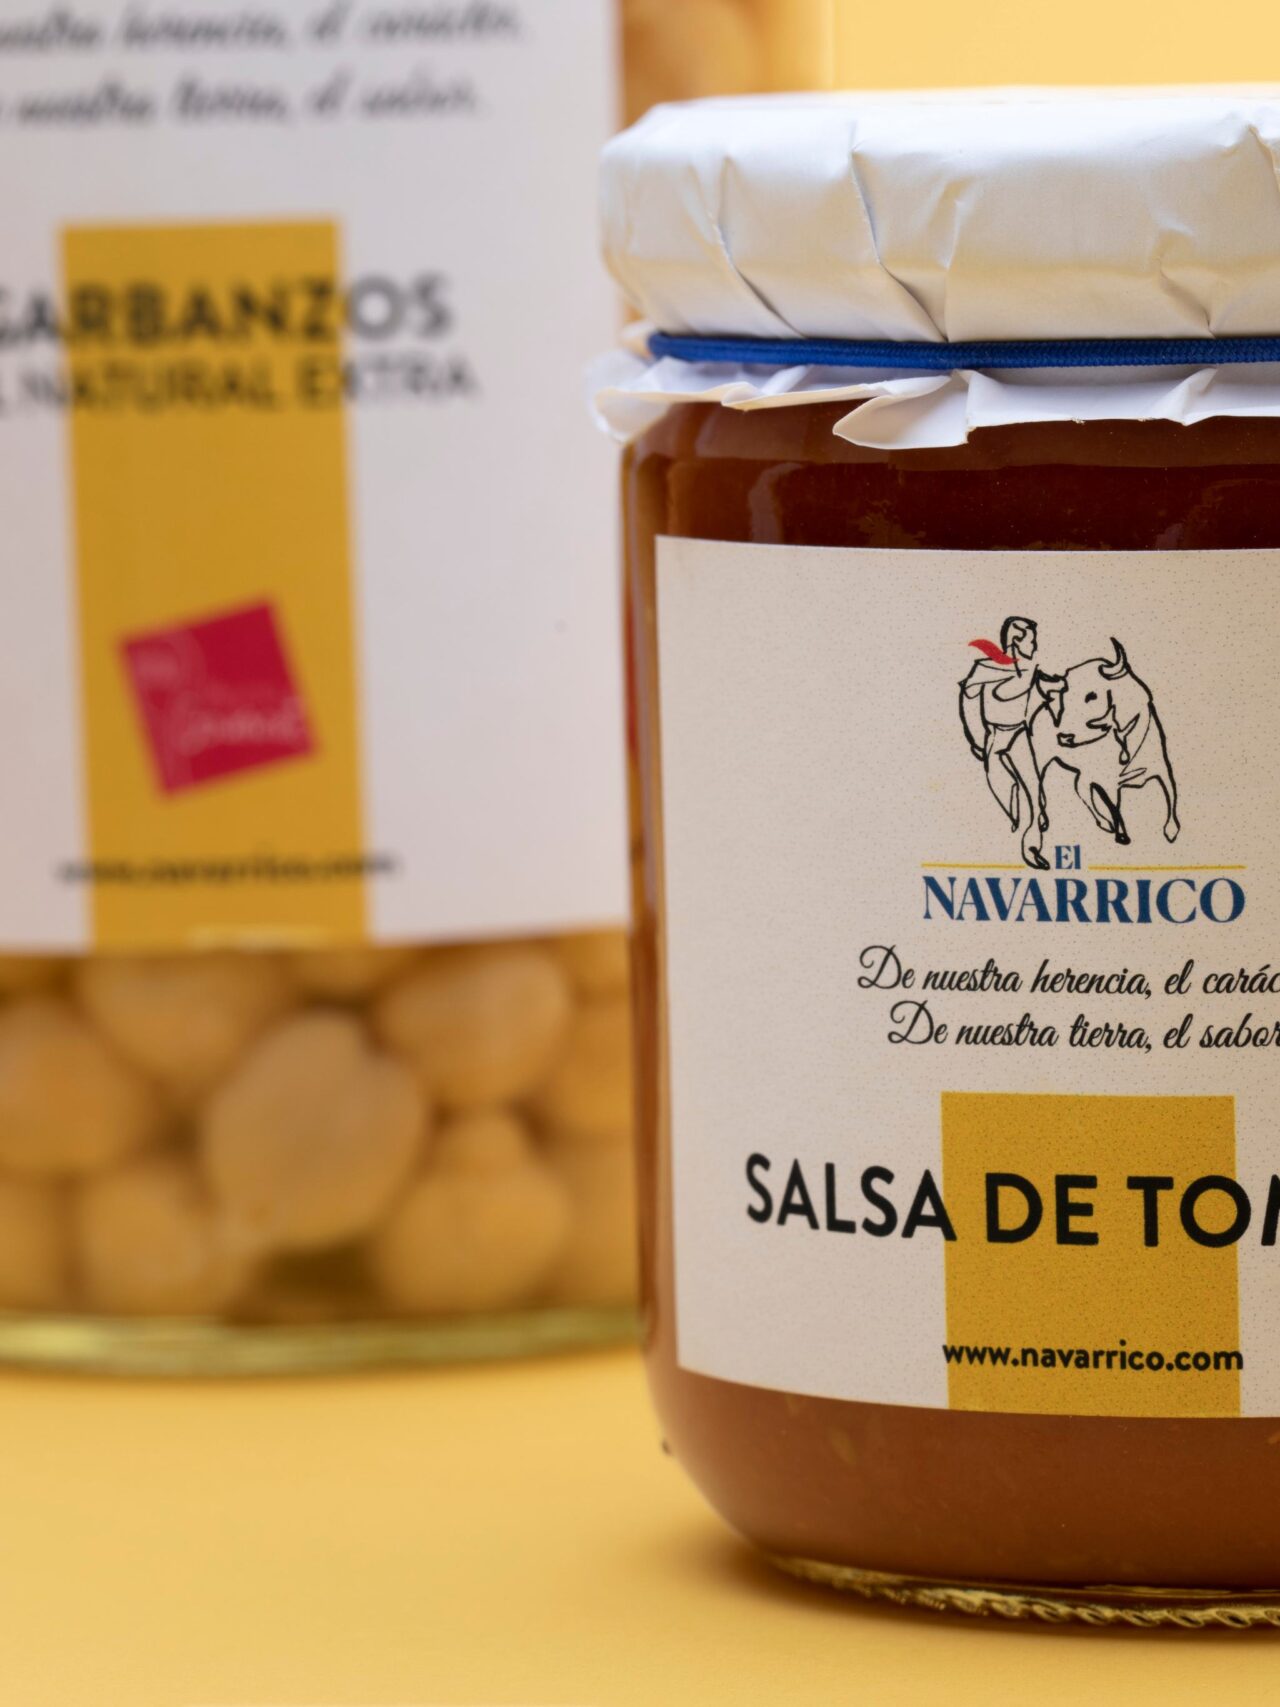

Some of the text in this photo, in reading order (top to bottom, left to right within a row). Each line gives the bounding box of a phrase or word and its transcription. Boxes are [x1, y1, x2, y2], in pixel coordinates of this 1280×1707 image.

[1054, 844, 1082, 870] El
[922, 875, 1247, 924] NAVARRICO
[857, 945, 915, 990] De
[921, 958, 1023, 993] nuestra
[1030, 958, 1152, 999] herencia,
[1164, 958, 1194, 994] el
[887, 1000, 948, 1045] De
[955, 1012, 1060, 1047] nuestra
[1069, 1013, 1152, 1053] tierra,
[1163, 1013, 1194, 1049] el
[746, 1153, 958, 1243] SALSA
[984, 1172, 1100, 1247] DE
[942, 1340, 1244, 1373] www.navarrico.com
